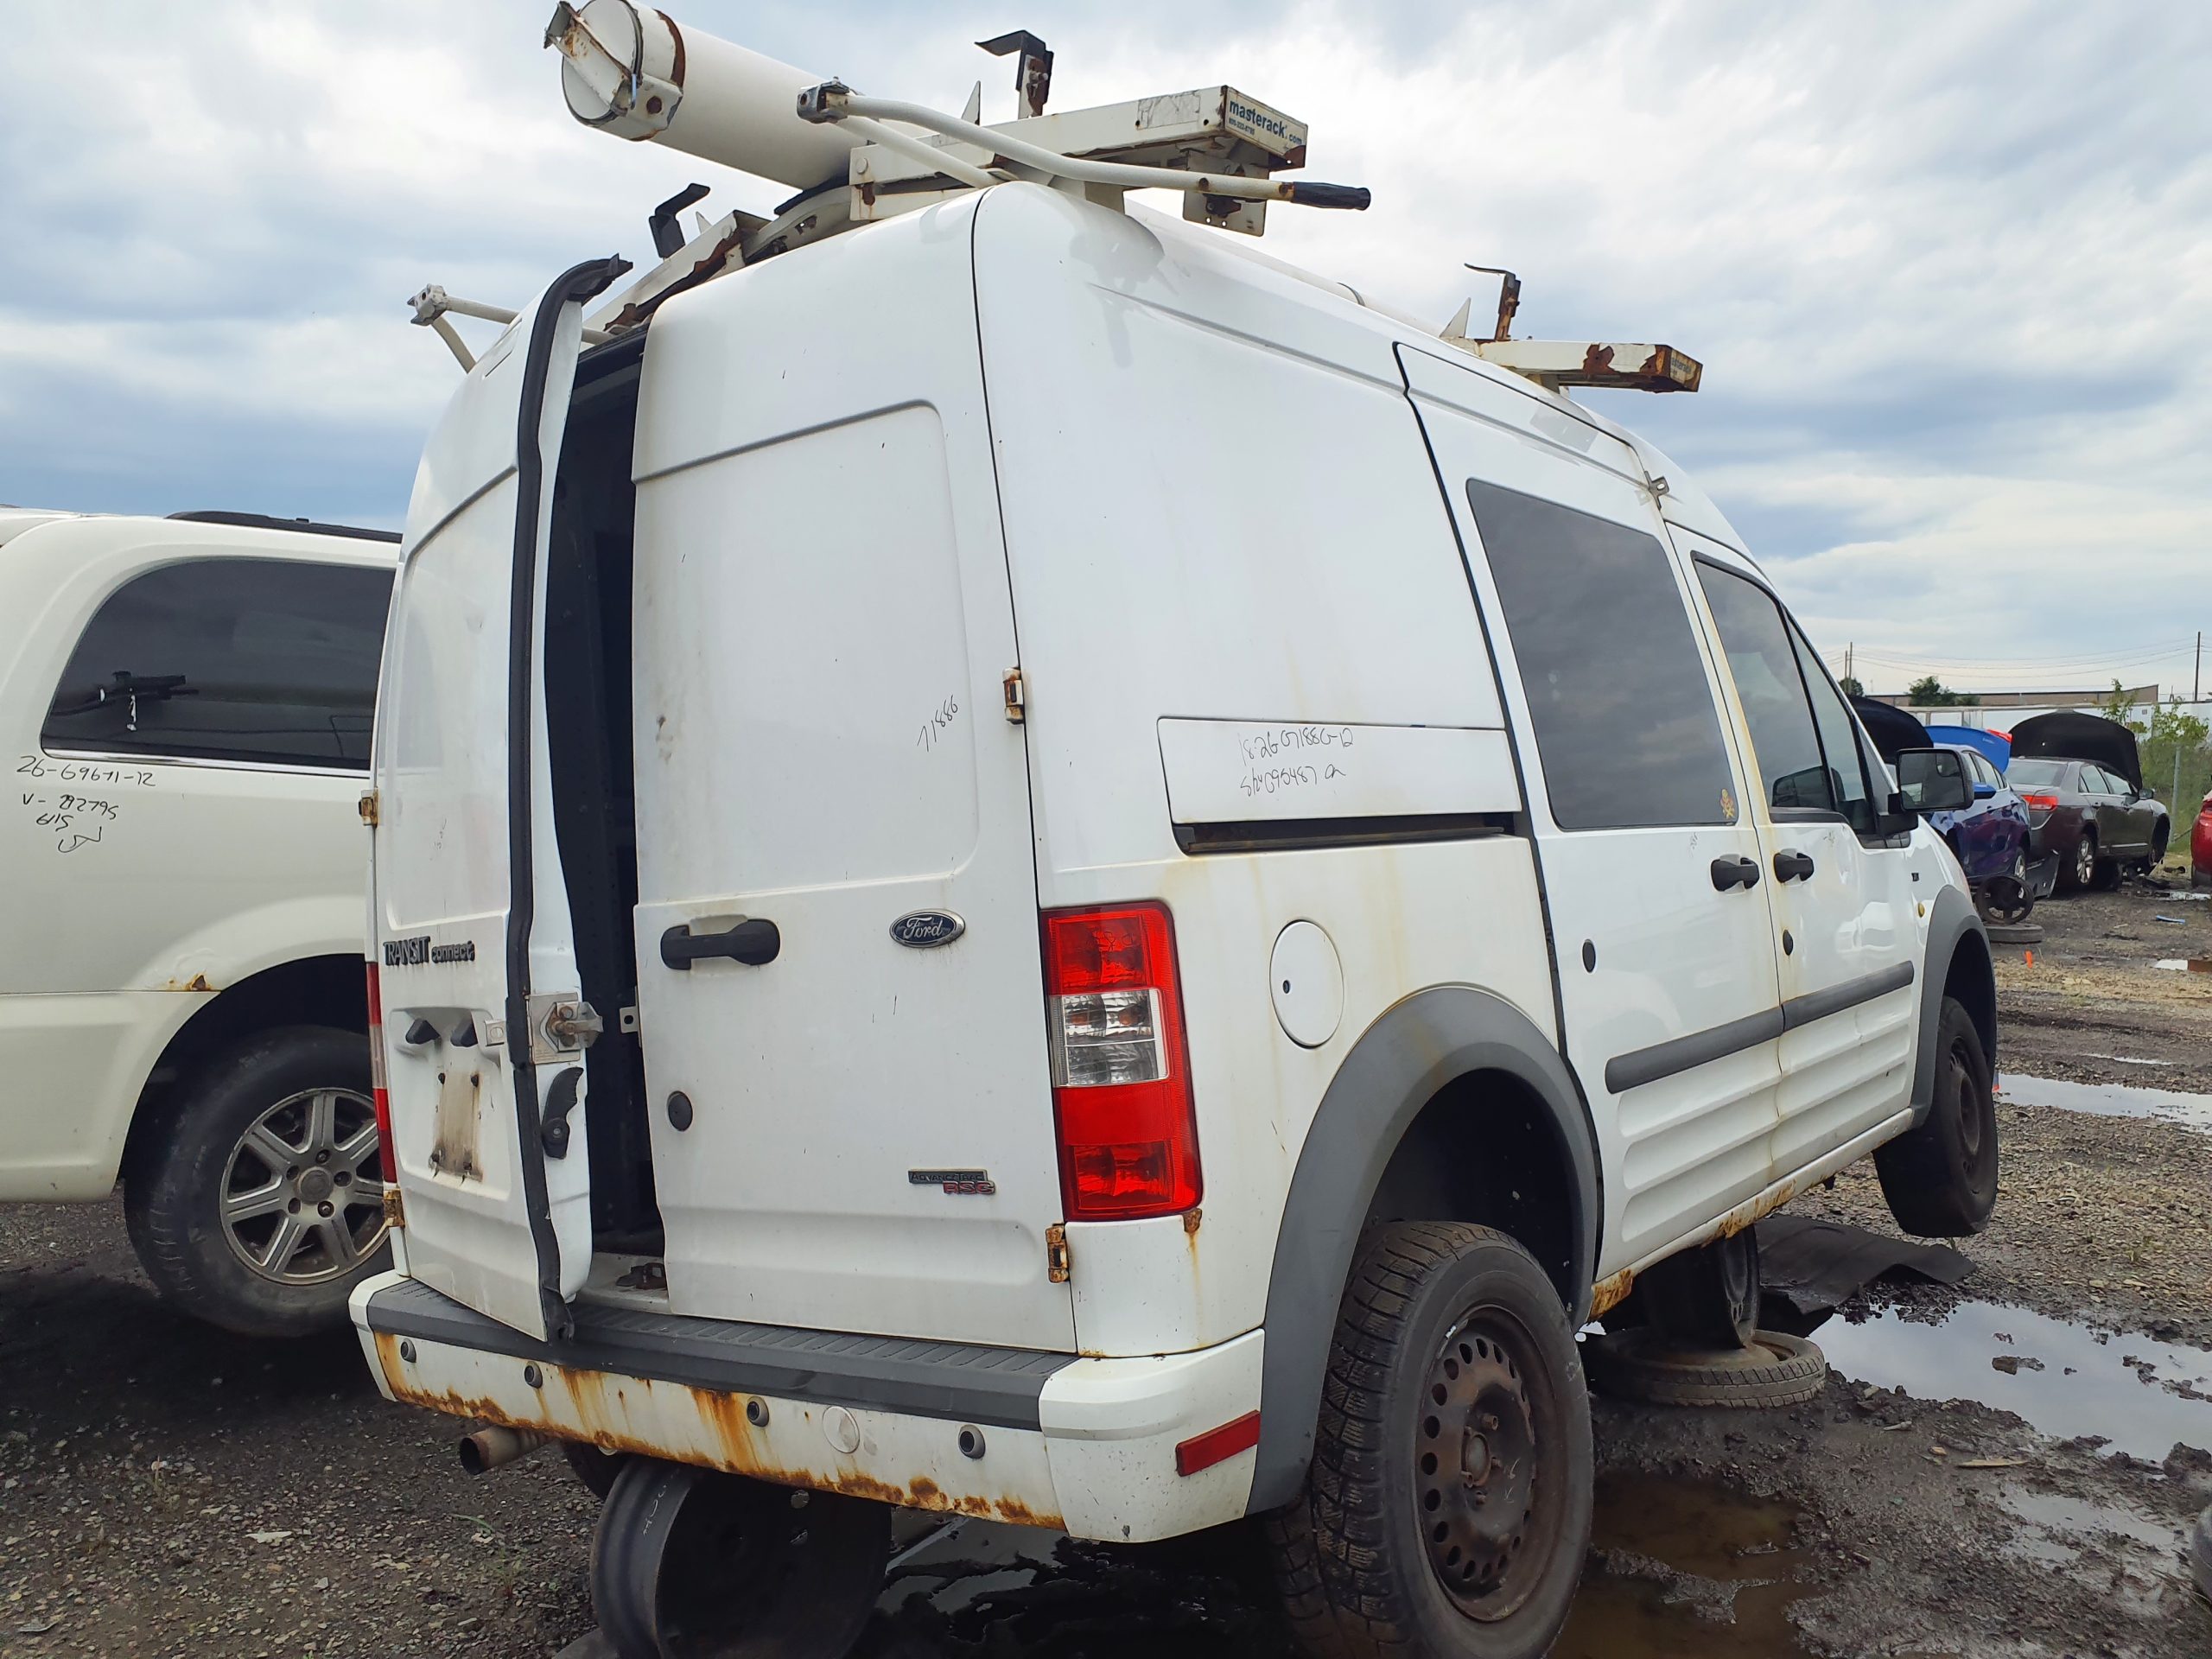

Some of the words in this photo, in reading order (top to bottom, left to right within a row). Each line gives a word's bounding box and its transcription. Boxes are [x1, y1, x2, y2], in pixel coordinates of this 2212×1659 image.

[902, 916, 944, 940] Ford
[383, 936, 431, 967] TRANSIT
[431, 940, 475, 963] connect
